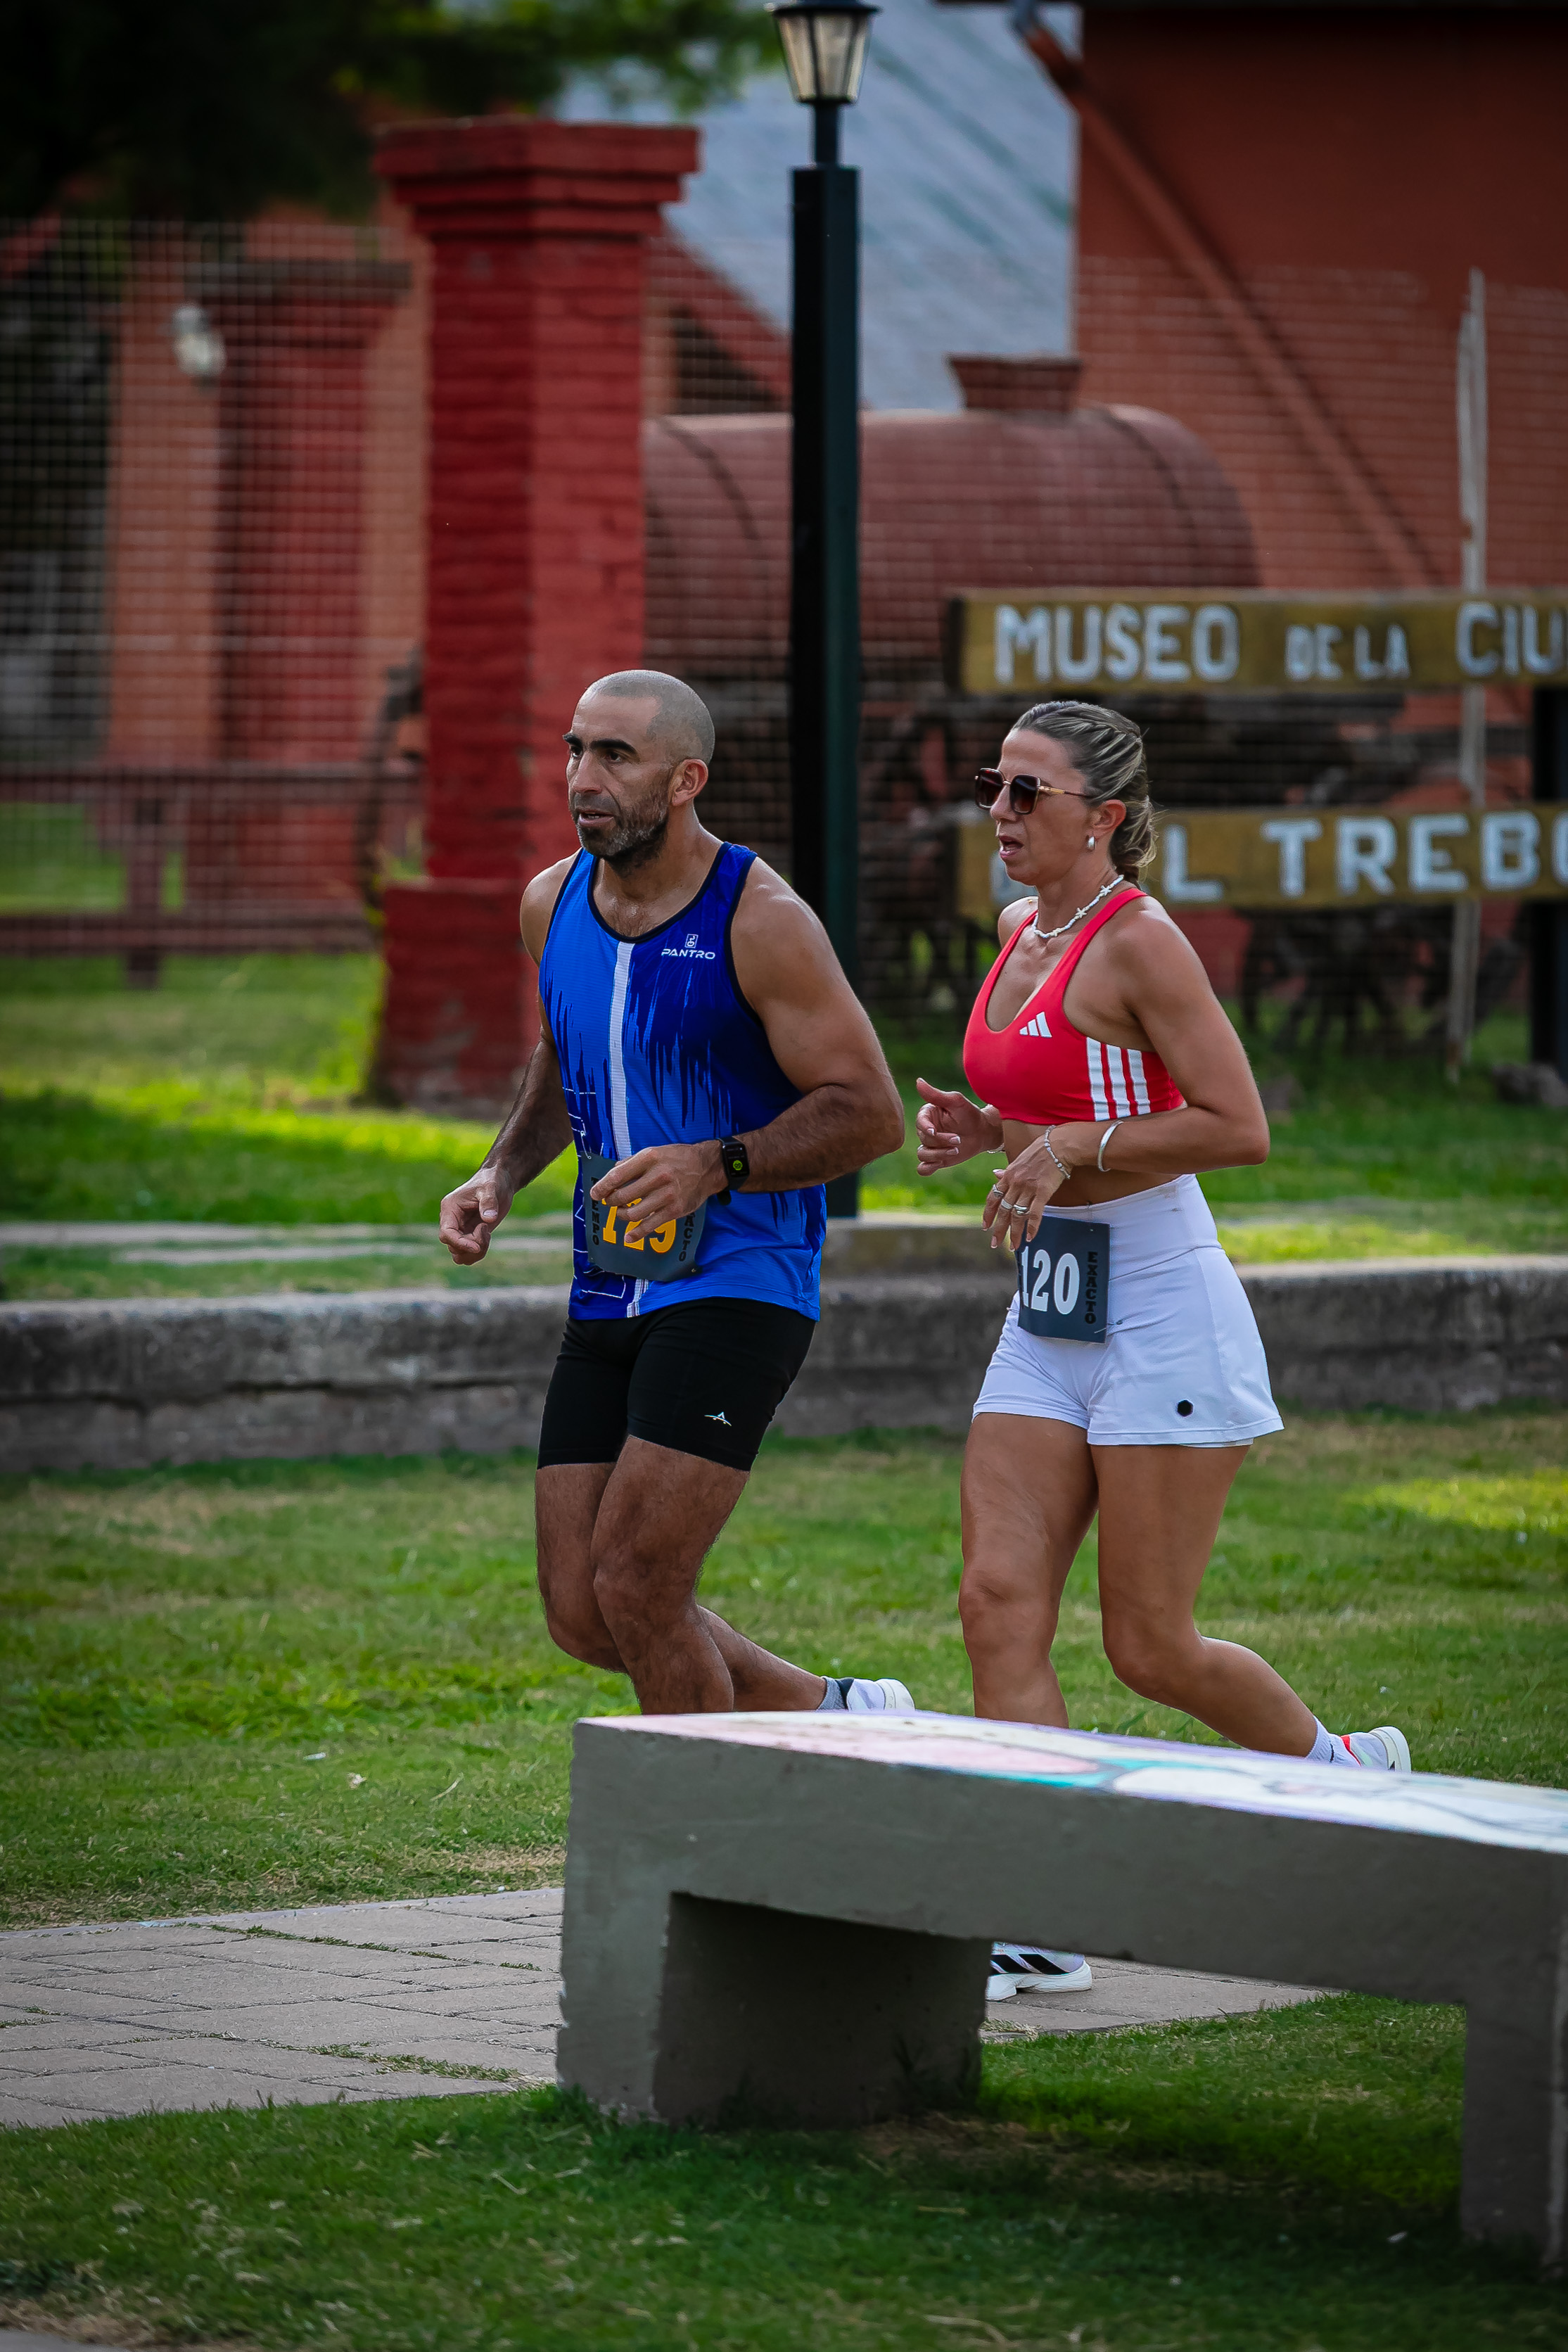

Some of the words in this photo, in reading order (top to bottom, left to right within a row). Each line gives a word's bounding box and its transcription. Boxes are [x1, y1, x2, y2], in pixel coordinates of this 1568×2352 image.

[994, 604, 1239, 684] MUSEO
[1285, 623, 1344, 680] DE
[1353, 622, 1410, 680] LA
[1455, 600, 1568, 676] CIU
[661, 948, 715, 960] PANTRO
[1021, 1246, 1080, 1315] 120
[1085, 1251, 1098, 1324] EXACTO
